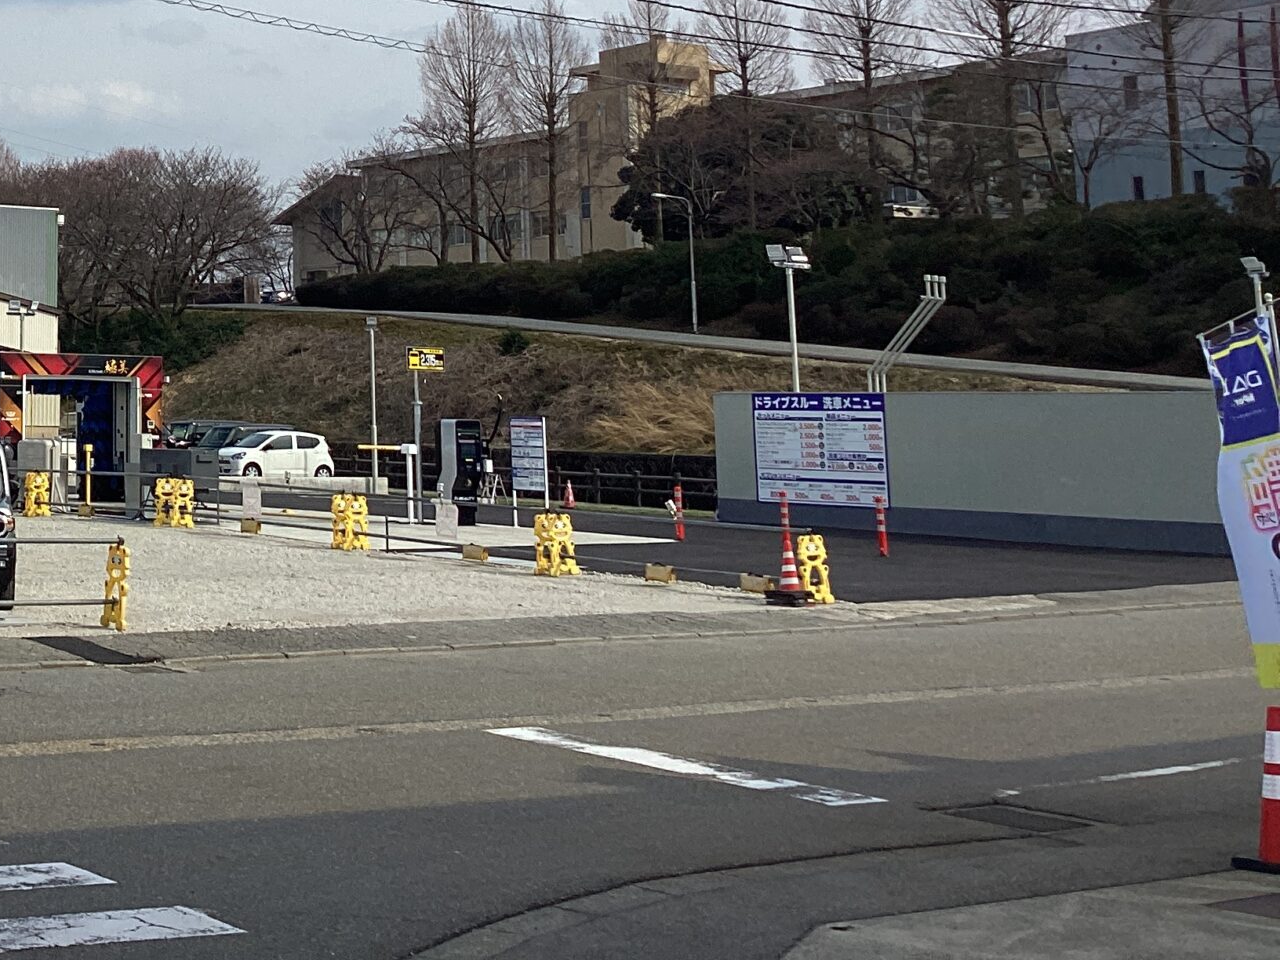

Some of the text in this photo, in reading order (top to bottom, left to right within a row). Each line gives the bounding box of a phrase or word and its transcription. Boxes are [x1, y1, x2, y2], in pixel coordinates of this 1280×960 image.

[754, 396, 882, 409] ドライブスルー 洗車メニュー
